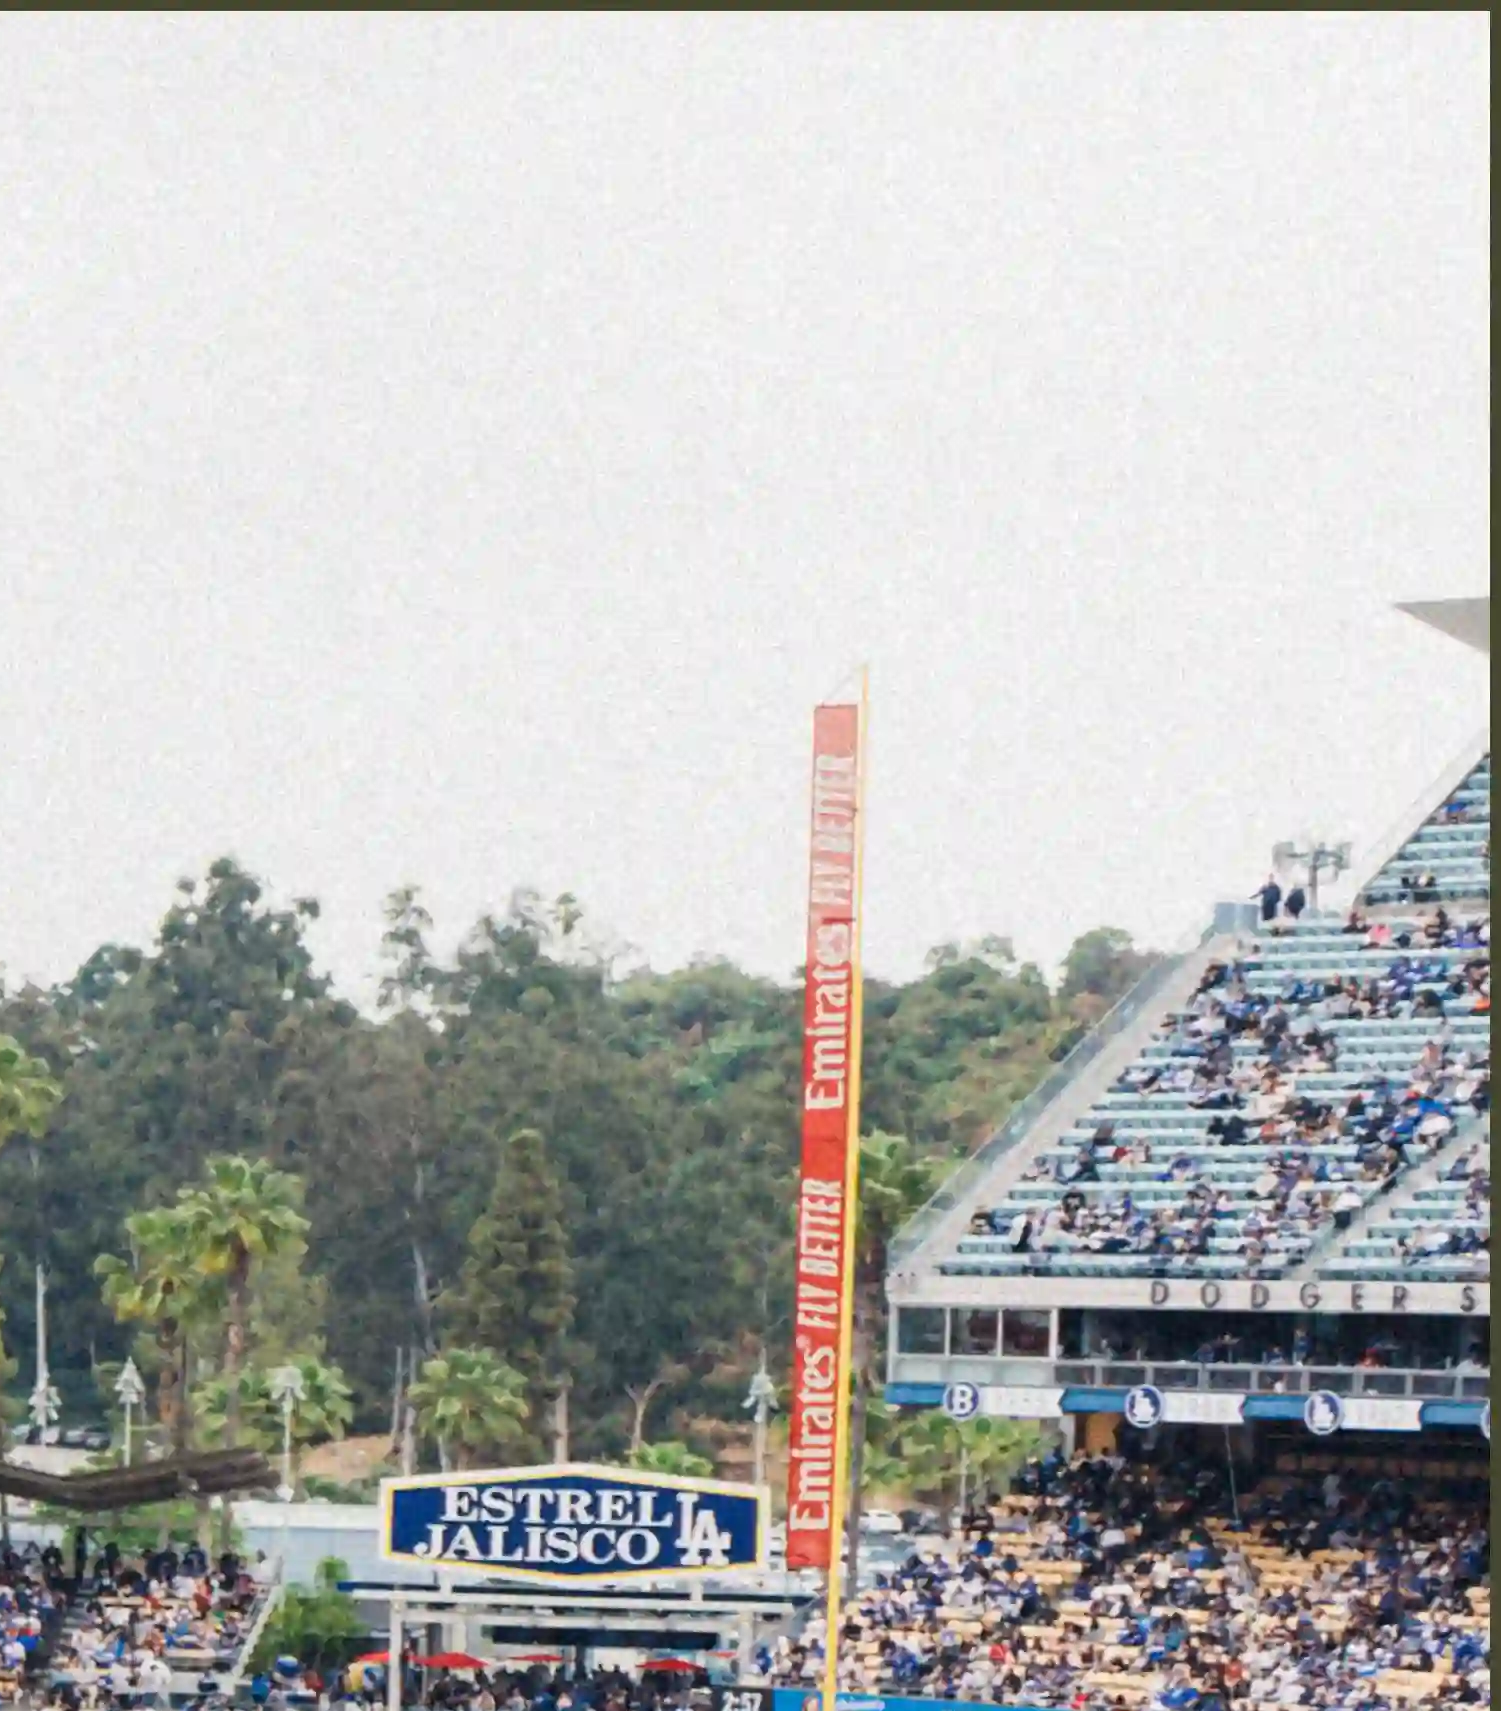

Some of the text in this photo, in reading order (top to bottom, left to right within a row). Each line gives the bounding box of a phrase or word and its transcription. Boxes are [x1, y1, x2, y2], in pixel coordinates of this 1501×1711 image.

[804, 921, 852, 1111] Emirates
[1150, 1280, 1480, 1312] DODGERS
[790, 1176, 842, 1531] Emirates FLY BETTER
[952, 1384, 972, 1414] B
[414, 1524, 660, 1564] JALISCO
